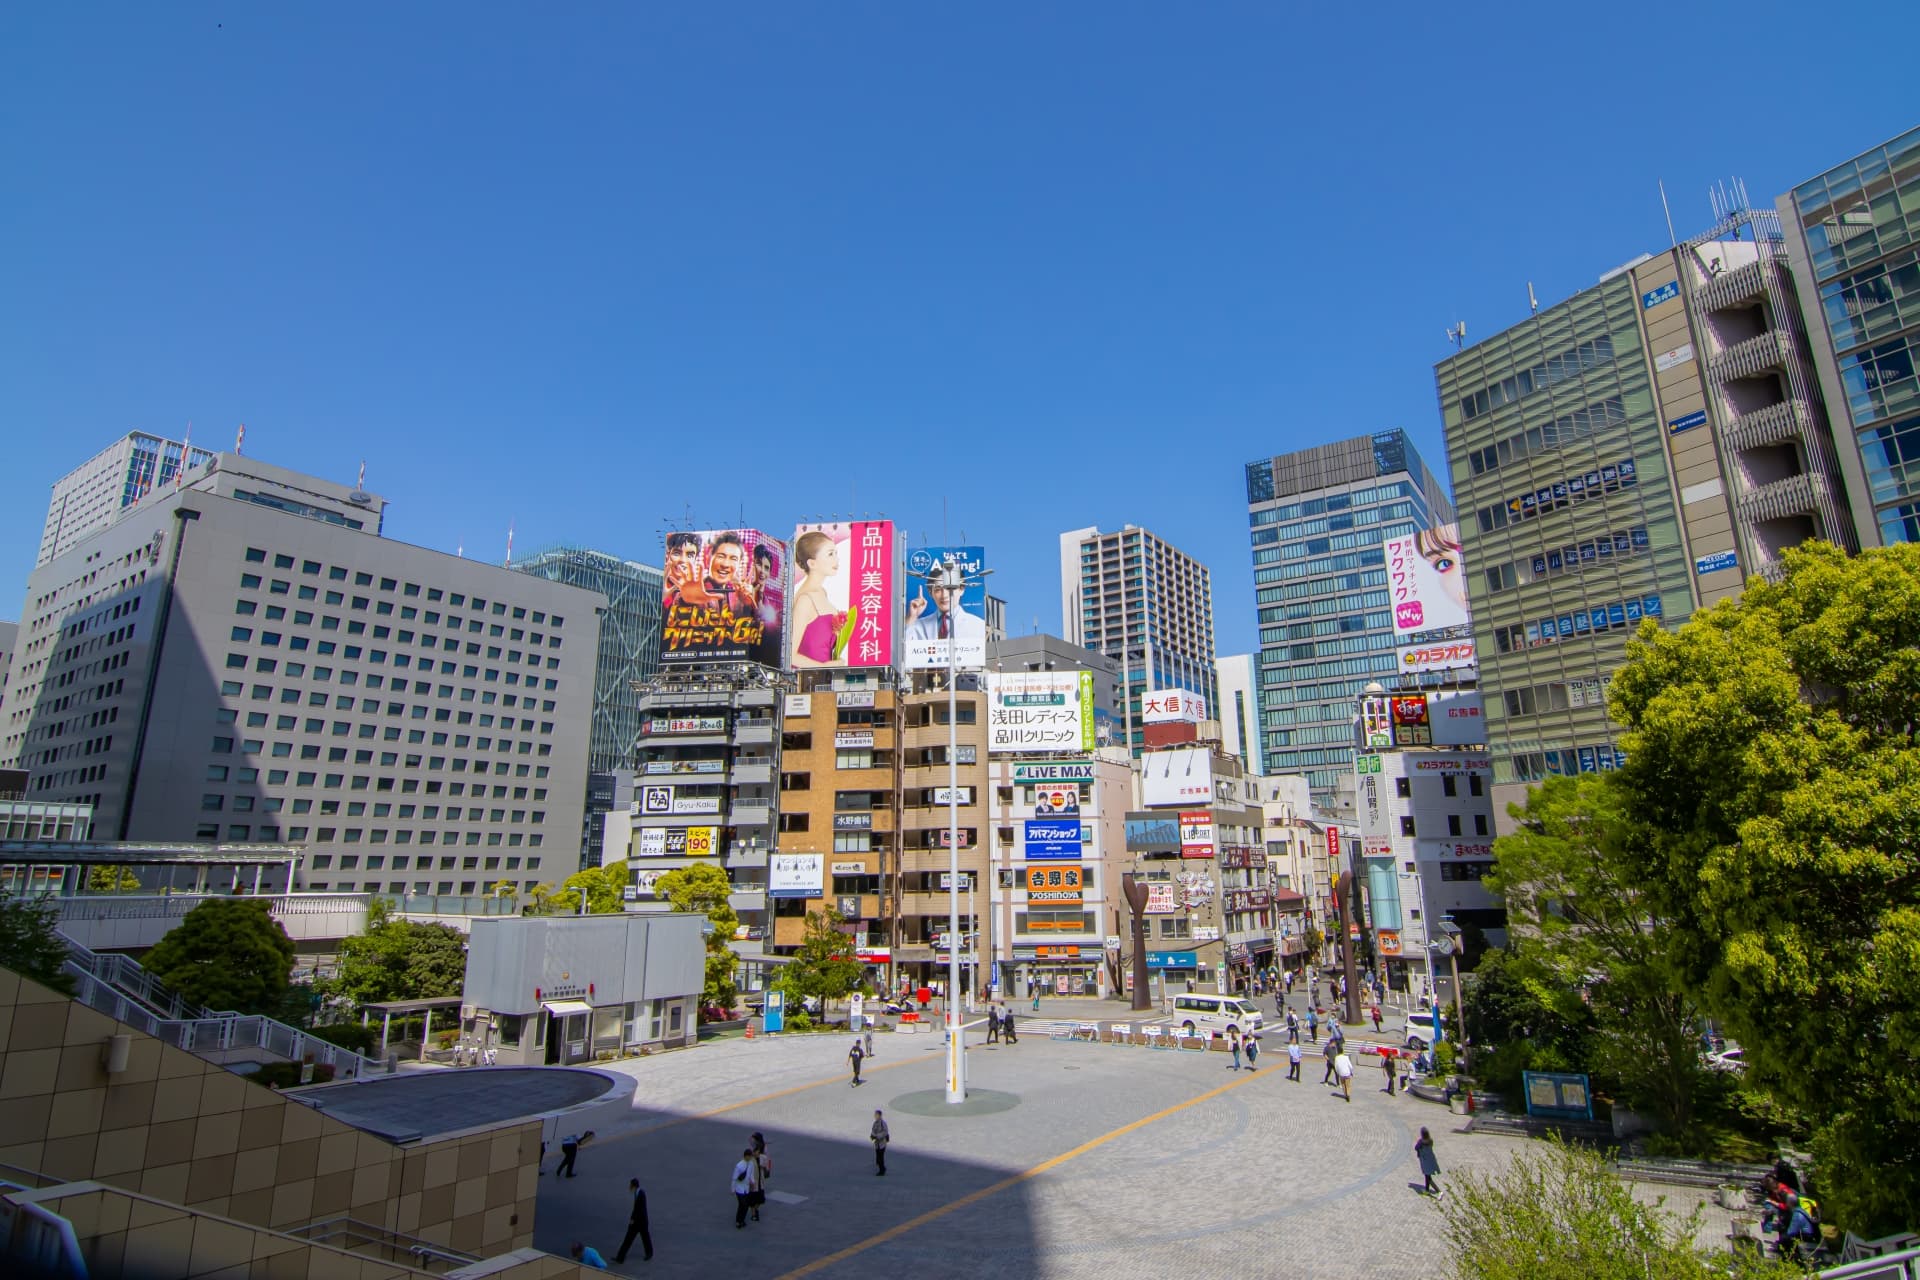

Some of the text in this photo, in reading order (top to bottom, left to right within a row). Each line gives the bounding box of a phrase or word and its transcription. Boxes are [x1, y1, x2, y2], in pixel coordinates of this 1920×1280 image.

[1389, 542, 1408, 600] ワクワク
[859, 527, 883, 662] 品川美容外科
[667, 604, 736, 627] にしたん
[1543, 600, 1660, 637] 英会話イーオン
[1416, 645, 1473, 663] カラオケ
[1145, 696, 1180, 715] 大信
[1184, 697, 1205, 719] 大信
[1448, 707, 1480, 719] 広告募
[992, 709, 1078, 725] 浅田レディース
[995, 728, 1074, 744] 品川クリニック
[1027, 766, 1093, 778] LiVE MAX
[1423, 761, 1454, 770] カラオケ
[837, 815, 870, 825] 水野歯科
[1028, 829, 1077, 839] アパマンショップ
[687, 838, 708, 850] 190
[1031, 870, 1078, 886] 吉野家
